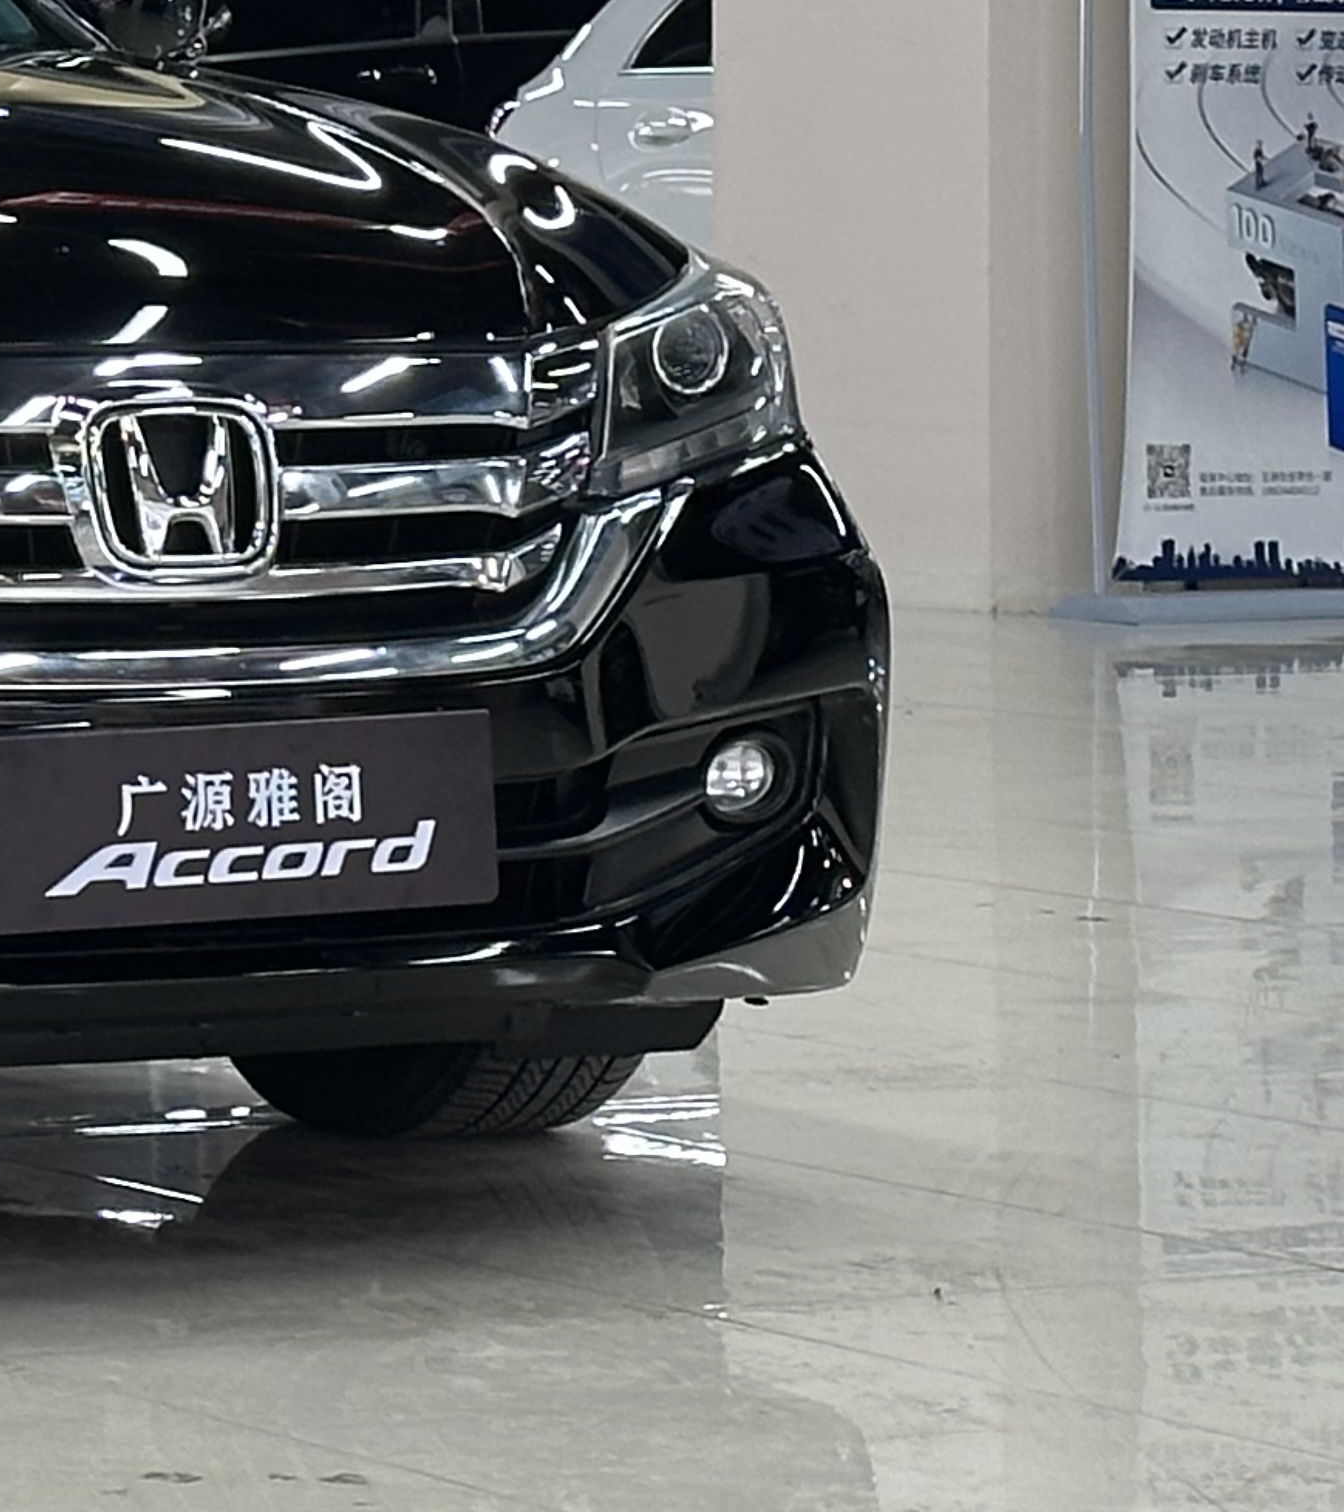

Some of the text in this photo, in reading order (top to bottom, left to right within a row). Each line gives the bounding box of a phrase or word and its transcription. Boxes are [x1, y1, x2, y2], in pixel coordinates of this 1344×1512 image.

[1231, 203, 1276, 249] 100
[117, 763, 363, 837] 广源雅阁
[44, 819, 437, 899] Accord
